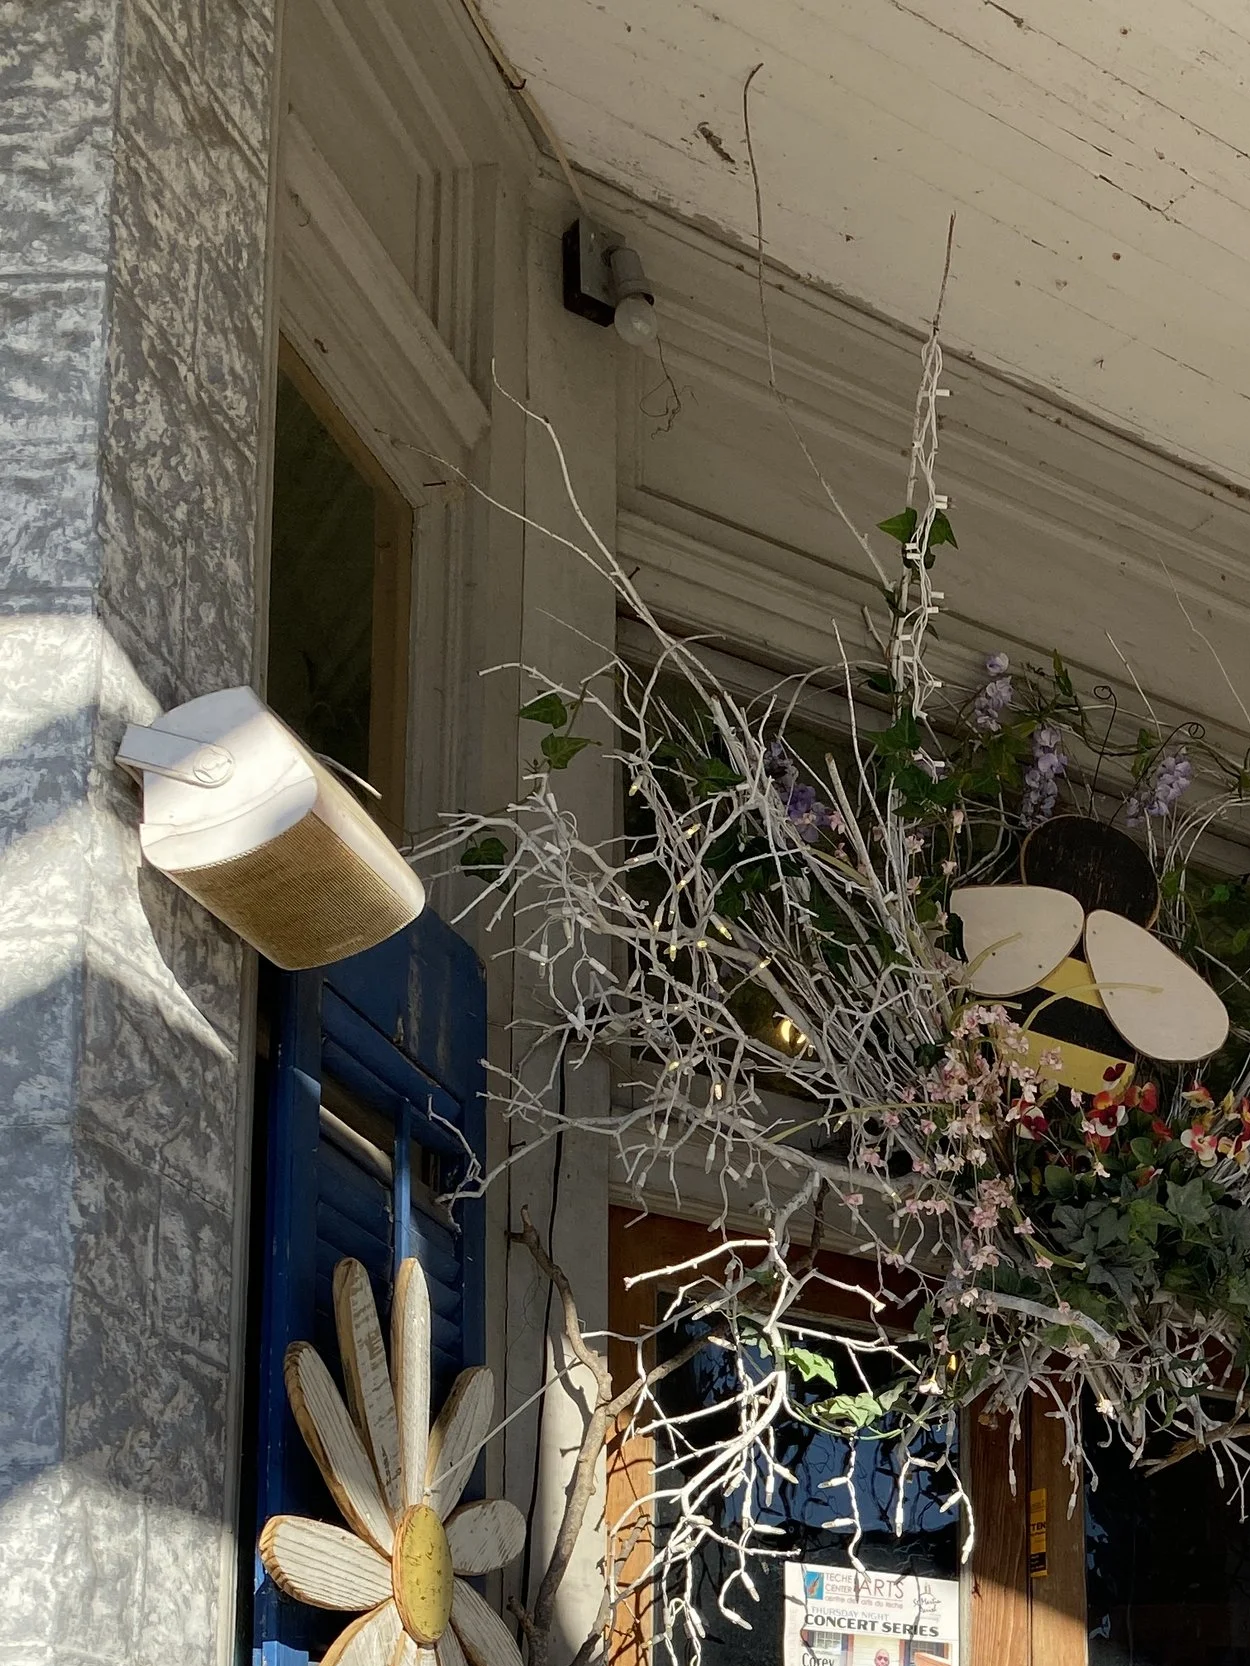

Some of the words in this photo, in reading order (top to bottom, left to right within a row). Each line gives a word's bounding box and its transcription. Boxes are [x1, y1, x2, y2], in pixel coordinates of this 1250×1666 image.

[825, 1572, 853, 1583] TECHE
[825, 1584, 853, 1594] CENTER
[858, 1578, 904, 1599] ARTS
[811, 1606, 858, 1618] THURSDAY
[861, 1610, 890, 1621] NIGHT
[804, 1613, 877, 1632] CONCERT
[881, 1621, 940, 1638] SERIES
